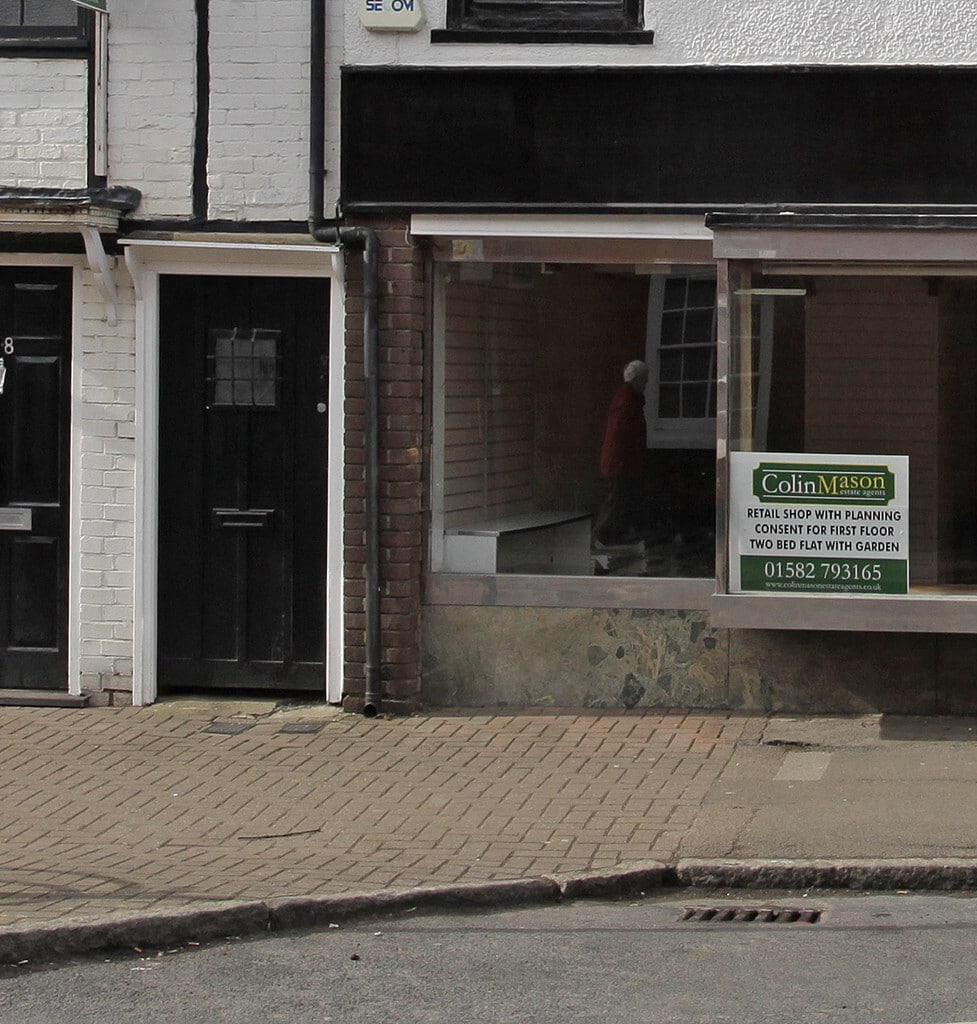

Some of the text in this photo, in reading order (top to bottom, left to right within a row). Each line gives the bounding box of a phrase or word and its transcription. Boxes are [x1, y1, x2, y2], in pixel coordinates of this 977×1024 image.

[4, 336, 14, 354] 8
[747, 508, 902, 521] RETAIL SHOP WITH PLANNING
[755, 523, 894, 537] CONSENT FOR FIRST FLOOR
[750, 539, 900, 552] TWO BED FLAT WITH GARDEN
[764, 561, 882, 581] 01582 793165
